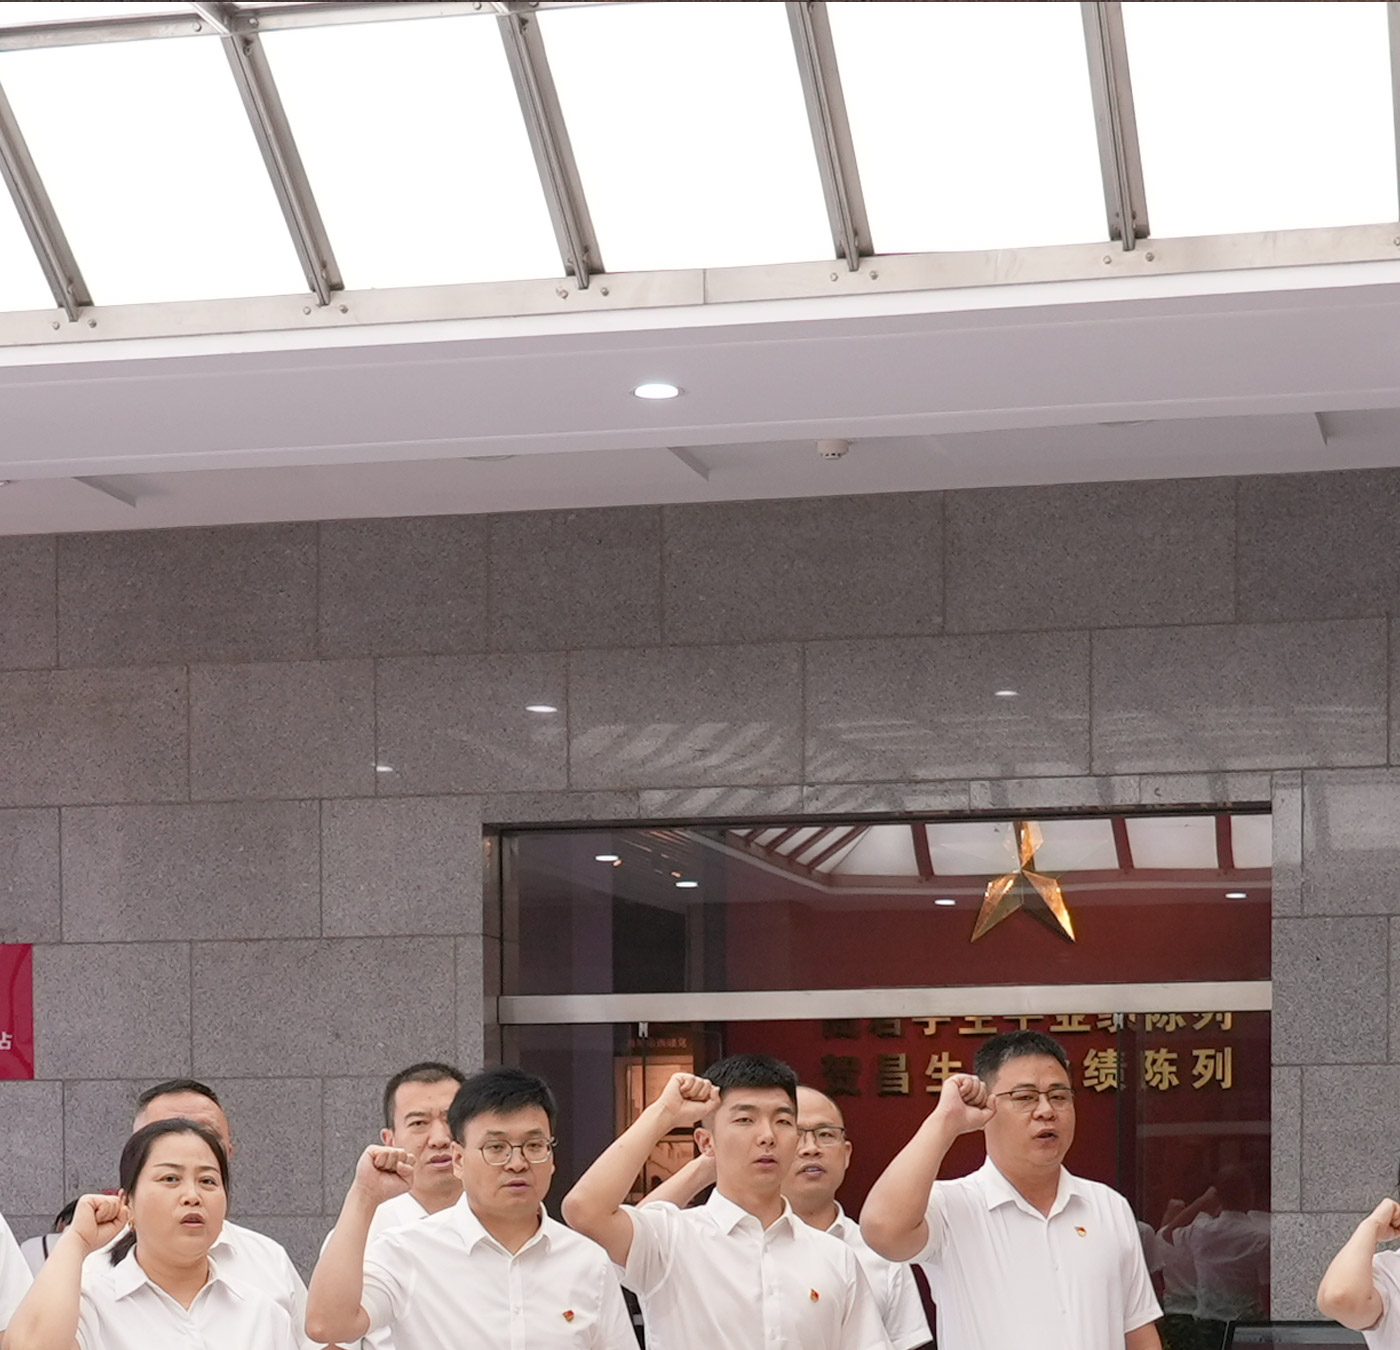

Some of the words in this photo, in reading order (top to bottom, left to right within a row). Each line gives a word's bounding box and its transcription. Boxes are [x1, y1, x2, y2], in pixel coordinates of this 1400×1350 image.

[821, 1047, 1232, 1098] 贺昌生绩陈列
